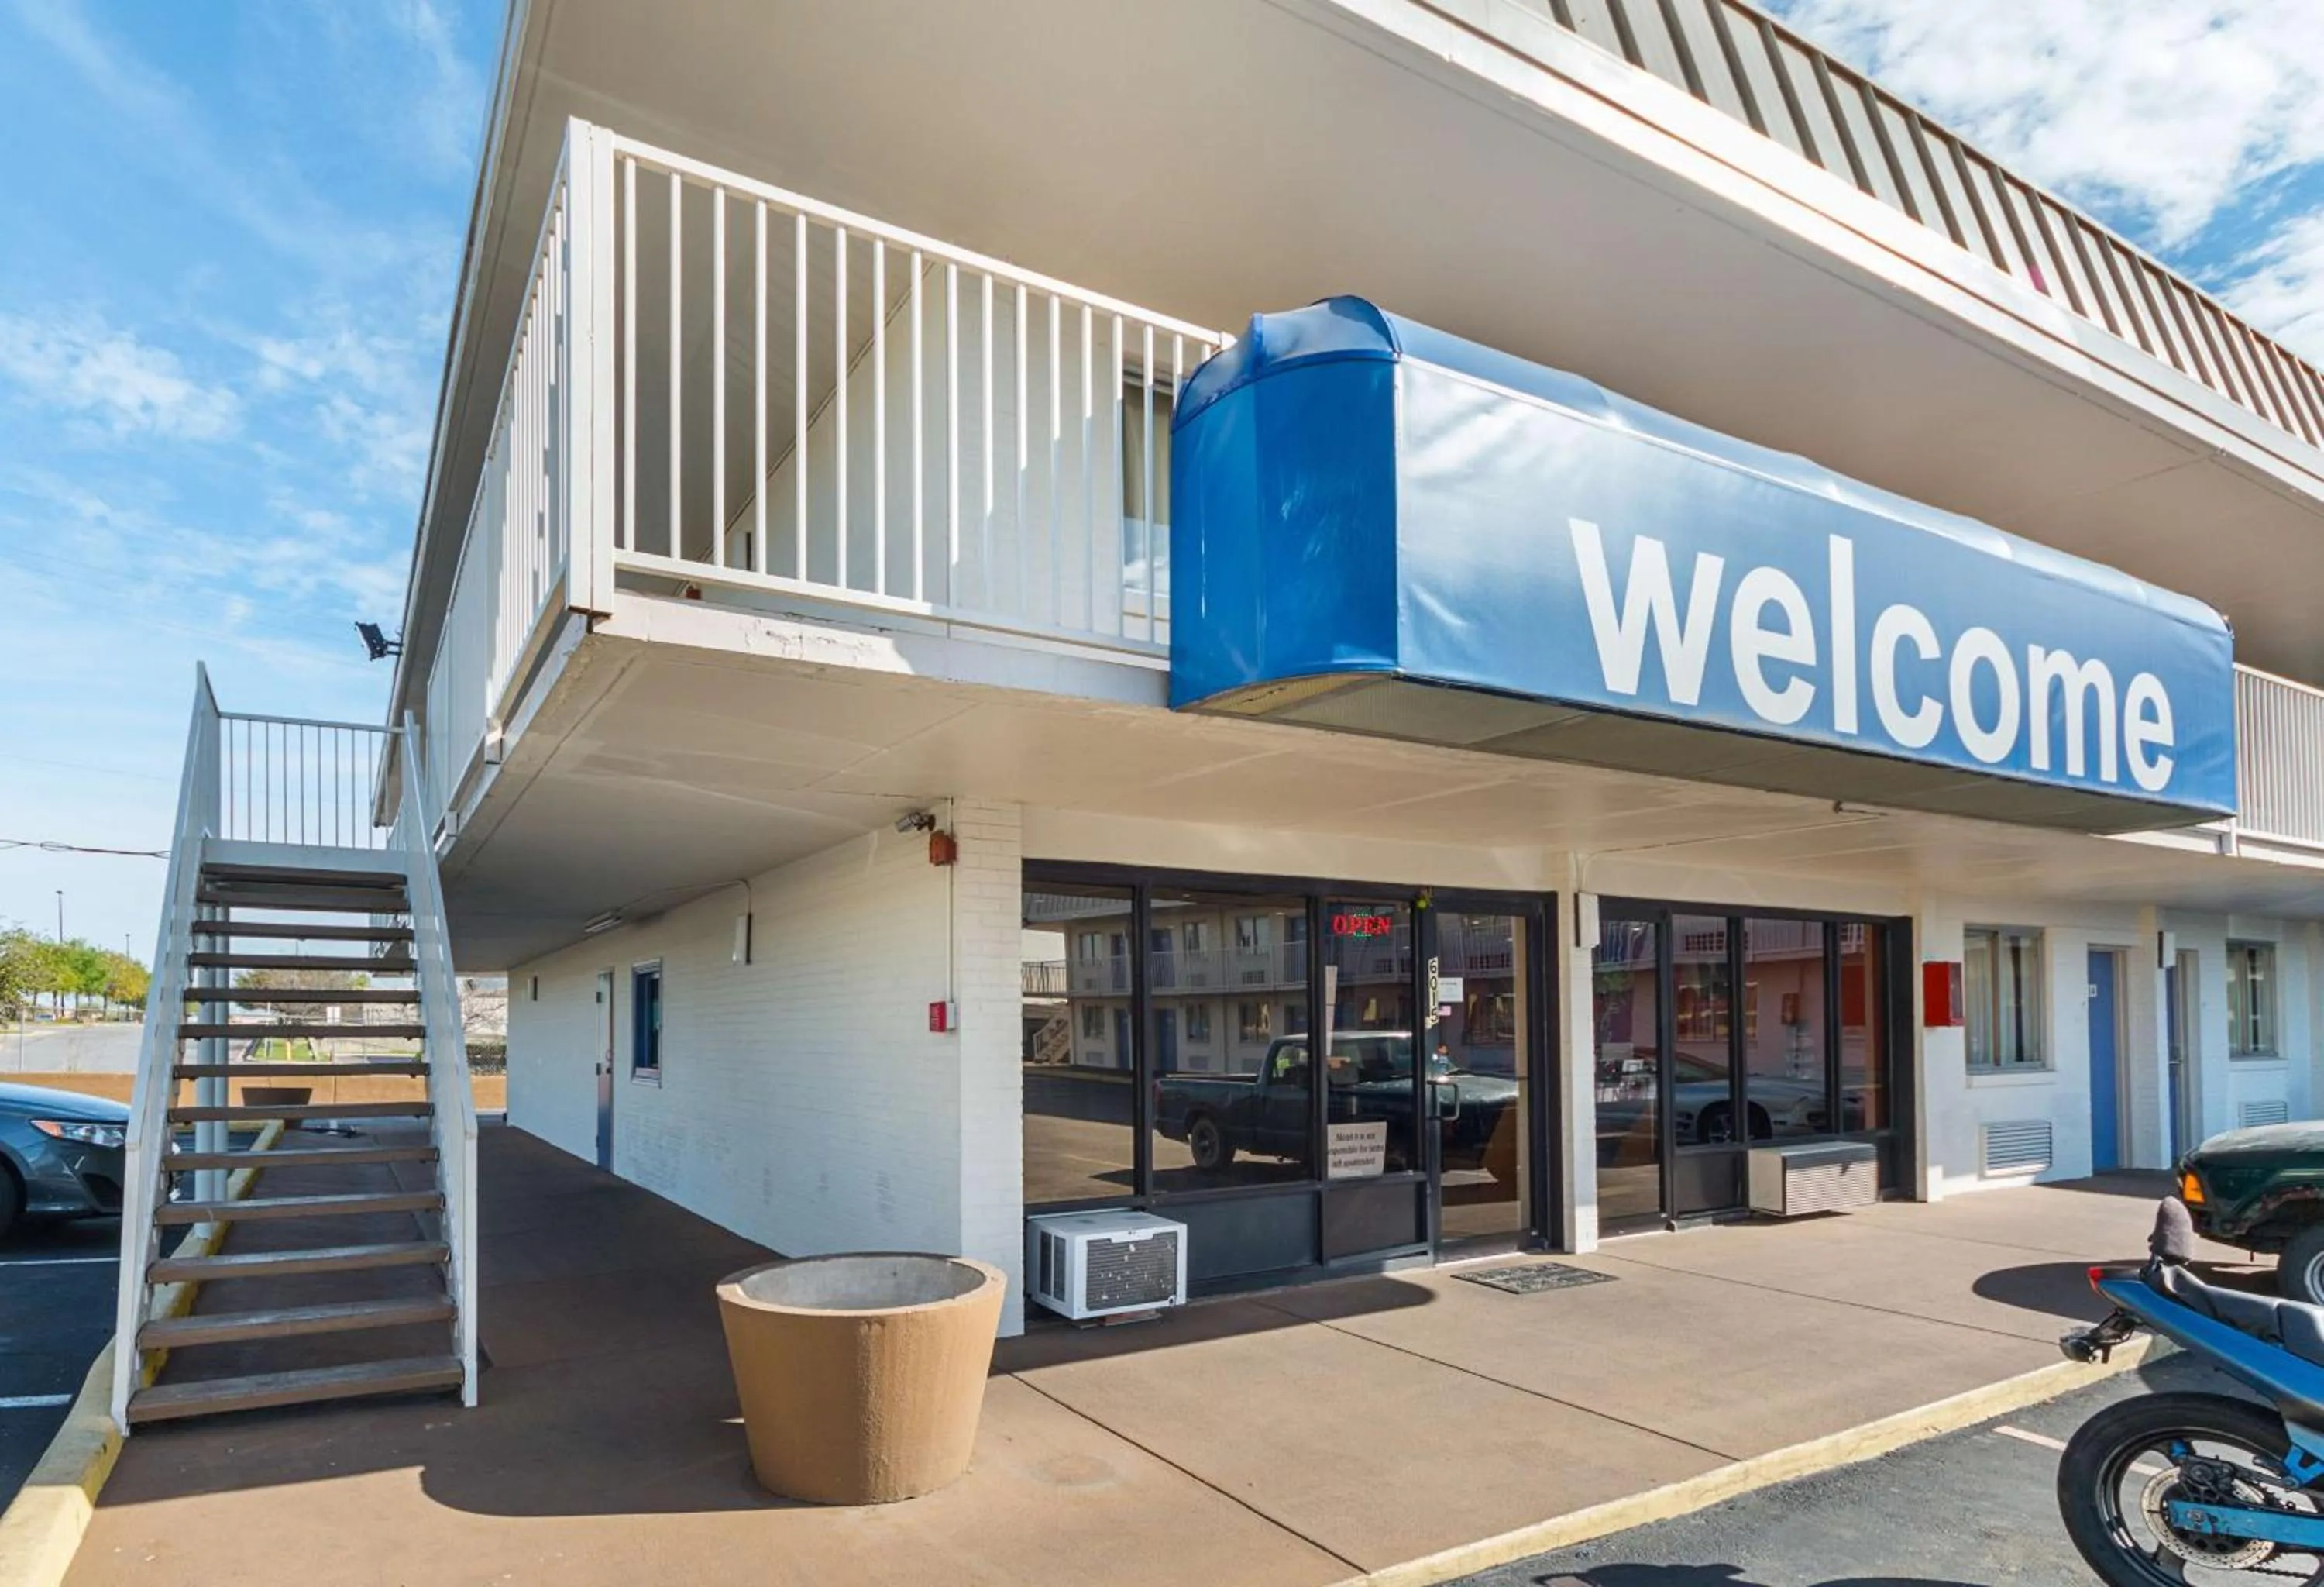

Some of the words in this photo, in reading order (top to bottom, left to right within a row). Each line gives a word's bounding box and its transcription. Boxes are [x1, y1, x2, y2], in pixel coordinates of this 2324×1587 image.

[1568, 518, 2174, 791] welcome
[1333, 915, 1391, 935] OPEN
[1429, 959, 1438, 1022] 6015
